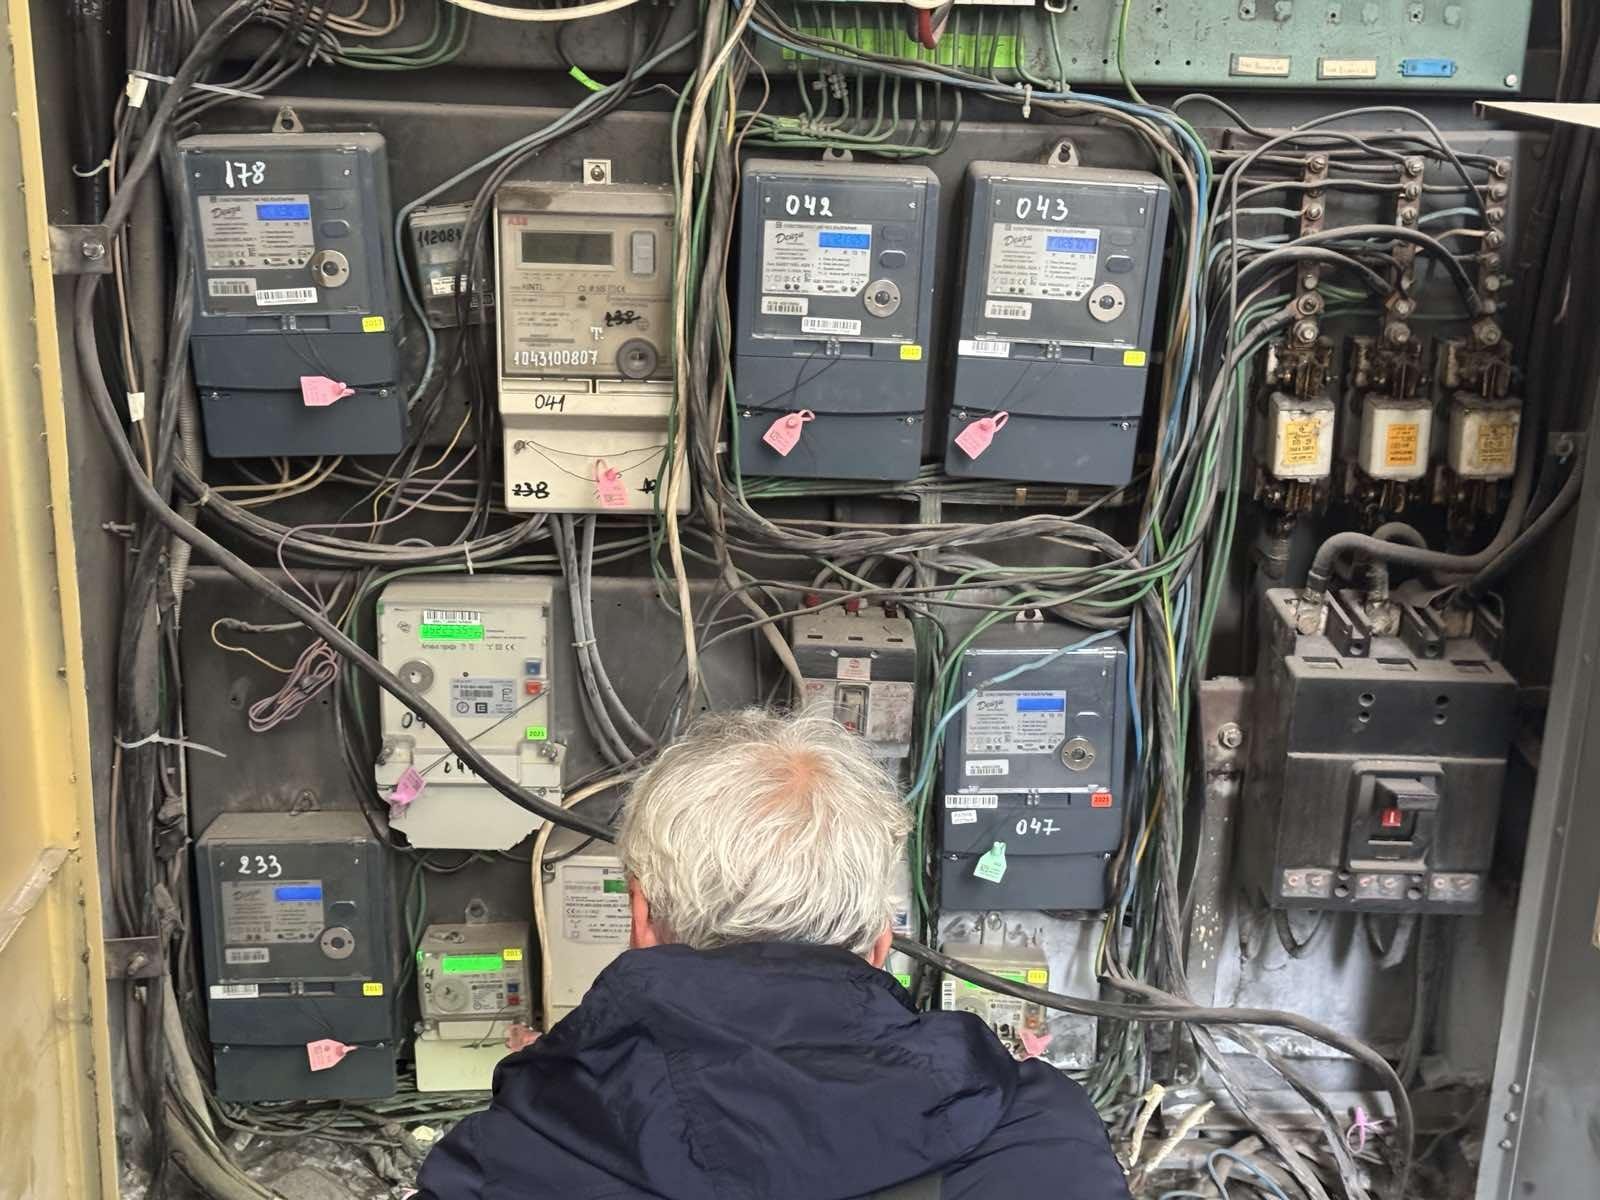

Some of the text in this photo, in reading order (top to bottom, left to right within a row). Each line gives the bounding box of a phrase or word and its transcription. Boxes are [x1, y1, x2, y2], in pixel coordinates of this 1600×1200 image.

[224, 160, 266, 188] 178
[785, 194, 833, 217] 042
[1015, 195, 1069, 221] 043
[513, 349, 599, 367] 1043100807
[534, 393, 566, 412] 041
[1015, 817, 1061, 836] 047
[238, 855, 283, 878] 233
